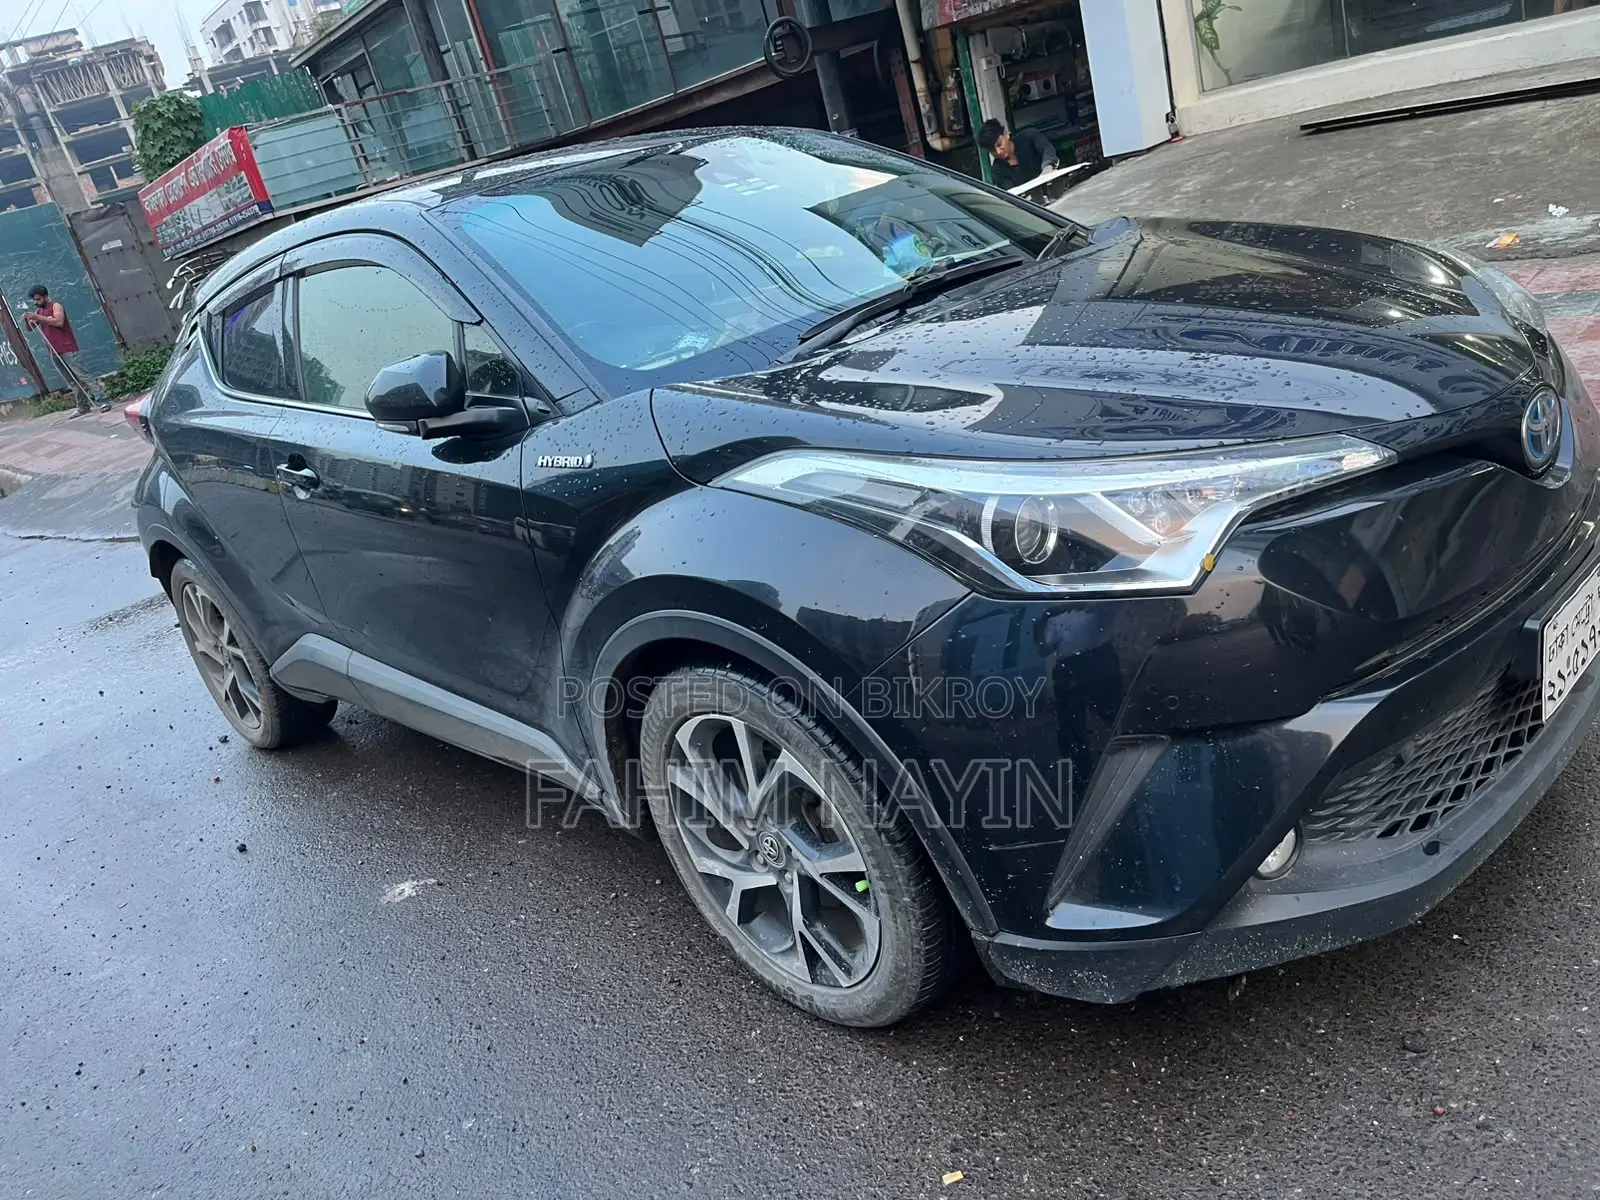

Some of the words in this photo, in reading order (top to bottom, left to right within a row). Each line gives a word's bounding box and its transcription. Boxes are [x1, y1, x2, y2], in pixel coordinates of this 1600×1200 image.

[537, 455, 583, 468] HYBRID
[1549, 624, 1569, 662] ঢাকা
[1547, 624, 1600, 702] ২১-৫১৭
